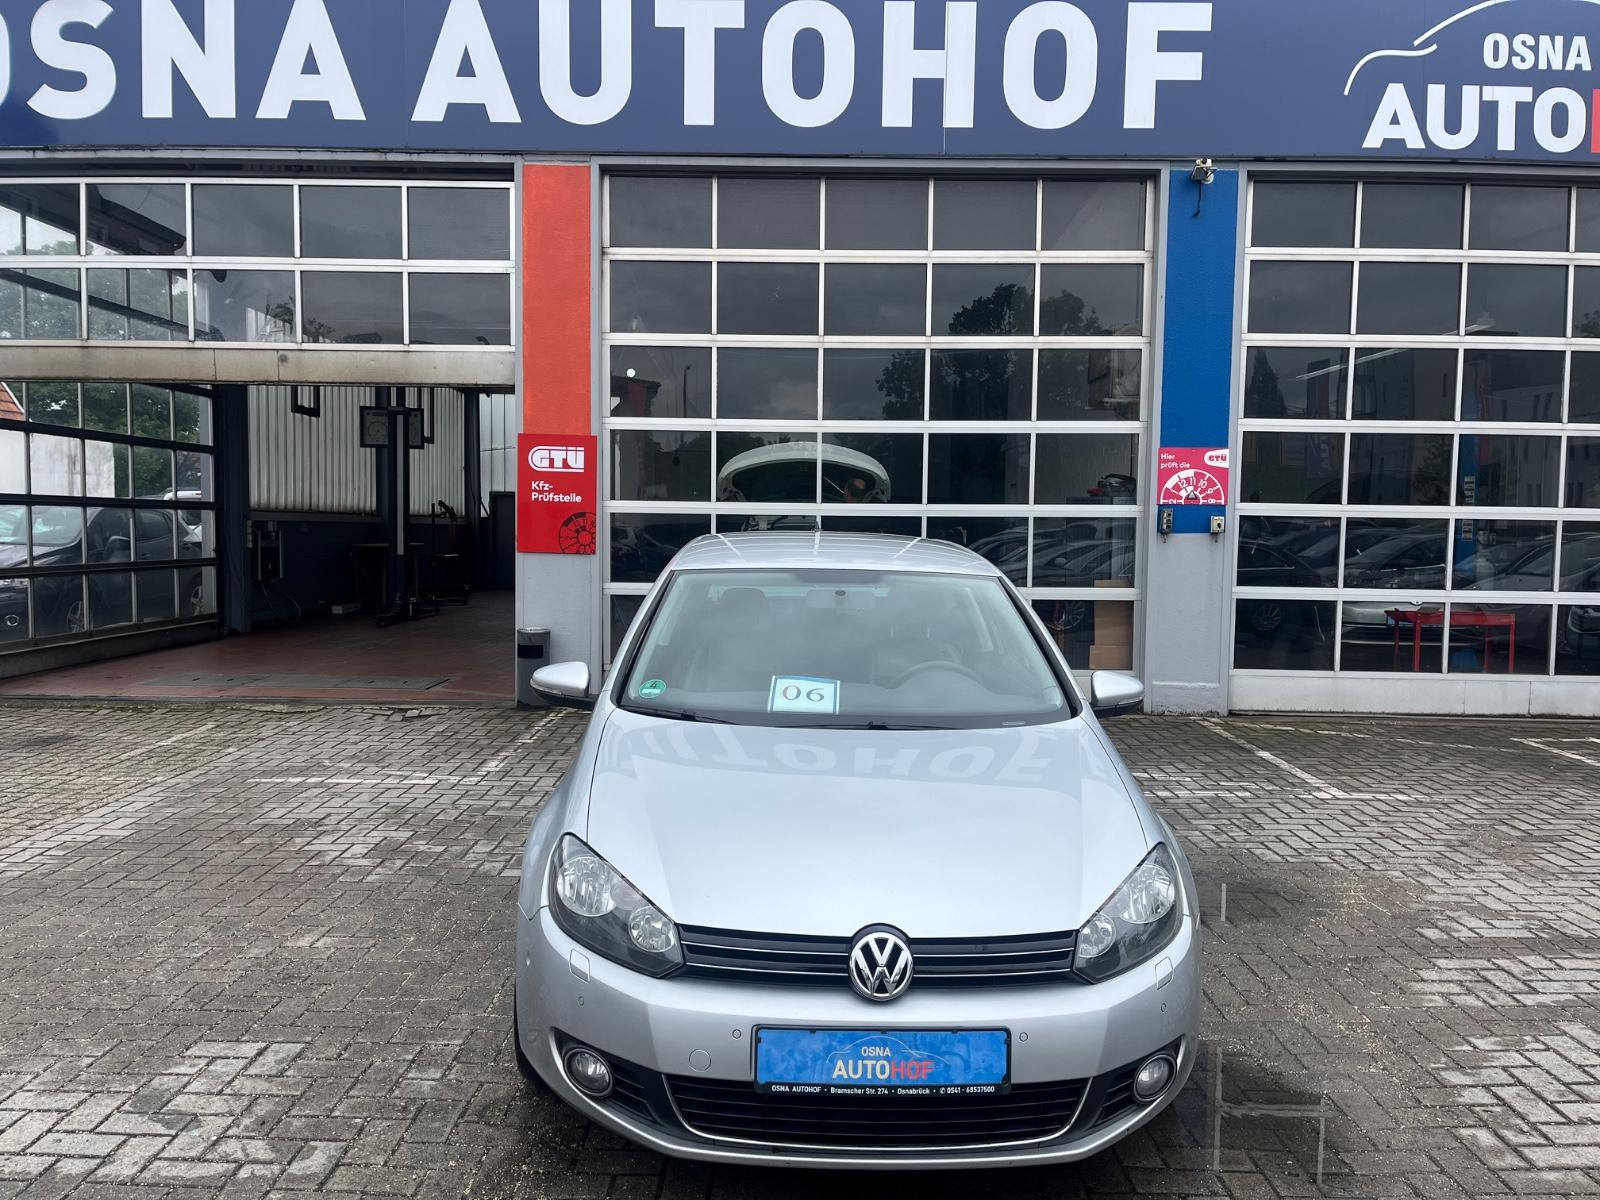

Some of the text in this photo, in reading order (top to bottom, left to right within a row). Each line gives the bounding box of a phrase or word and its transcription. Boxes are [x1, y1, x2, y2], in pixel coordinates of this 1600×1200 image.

[1483, 33, 1592, 71] OSNA
[0, 0, 1212, 129] SNA AUTOHOF
[1362, 82, 1600, 153] AUTO
[531, 481, 553, 490] Kfz-
[531, 492, 582, 502] Prüfstelle
[782, 685, 825, 702] 06
[861, 1046, 891, 1056] OSNA
[832, 1060, 935, 1080] AUTOHOF
